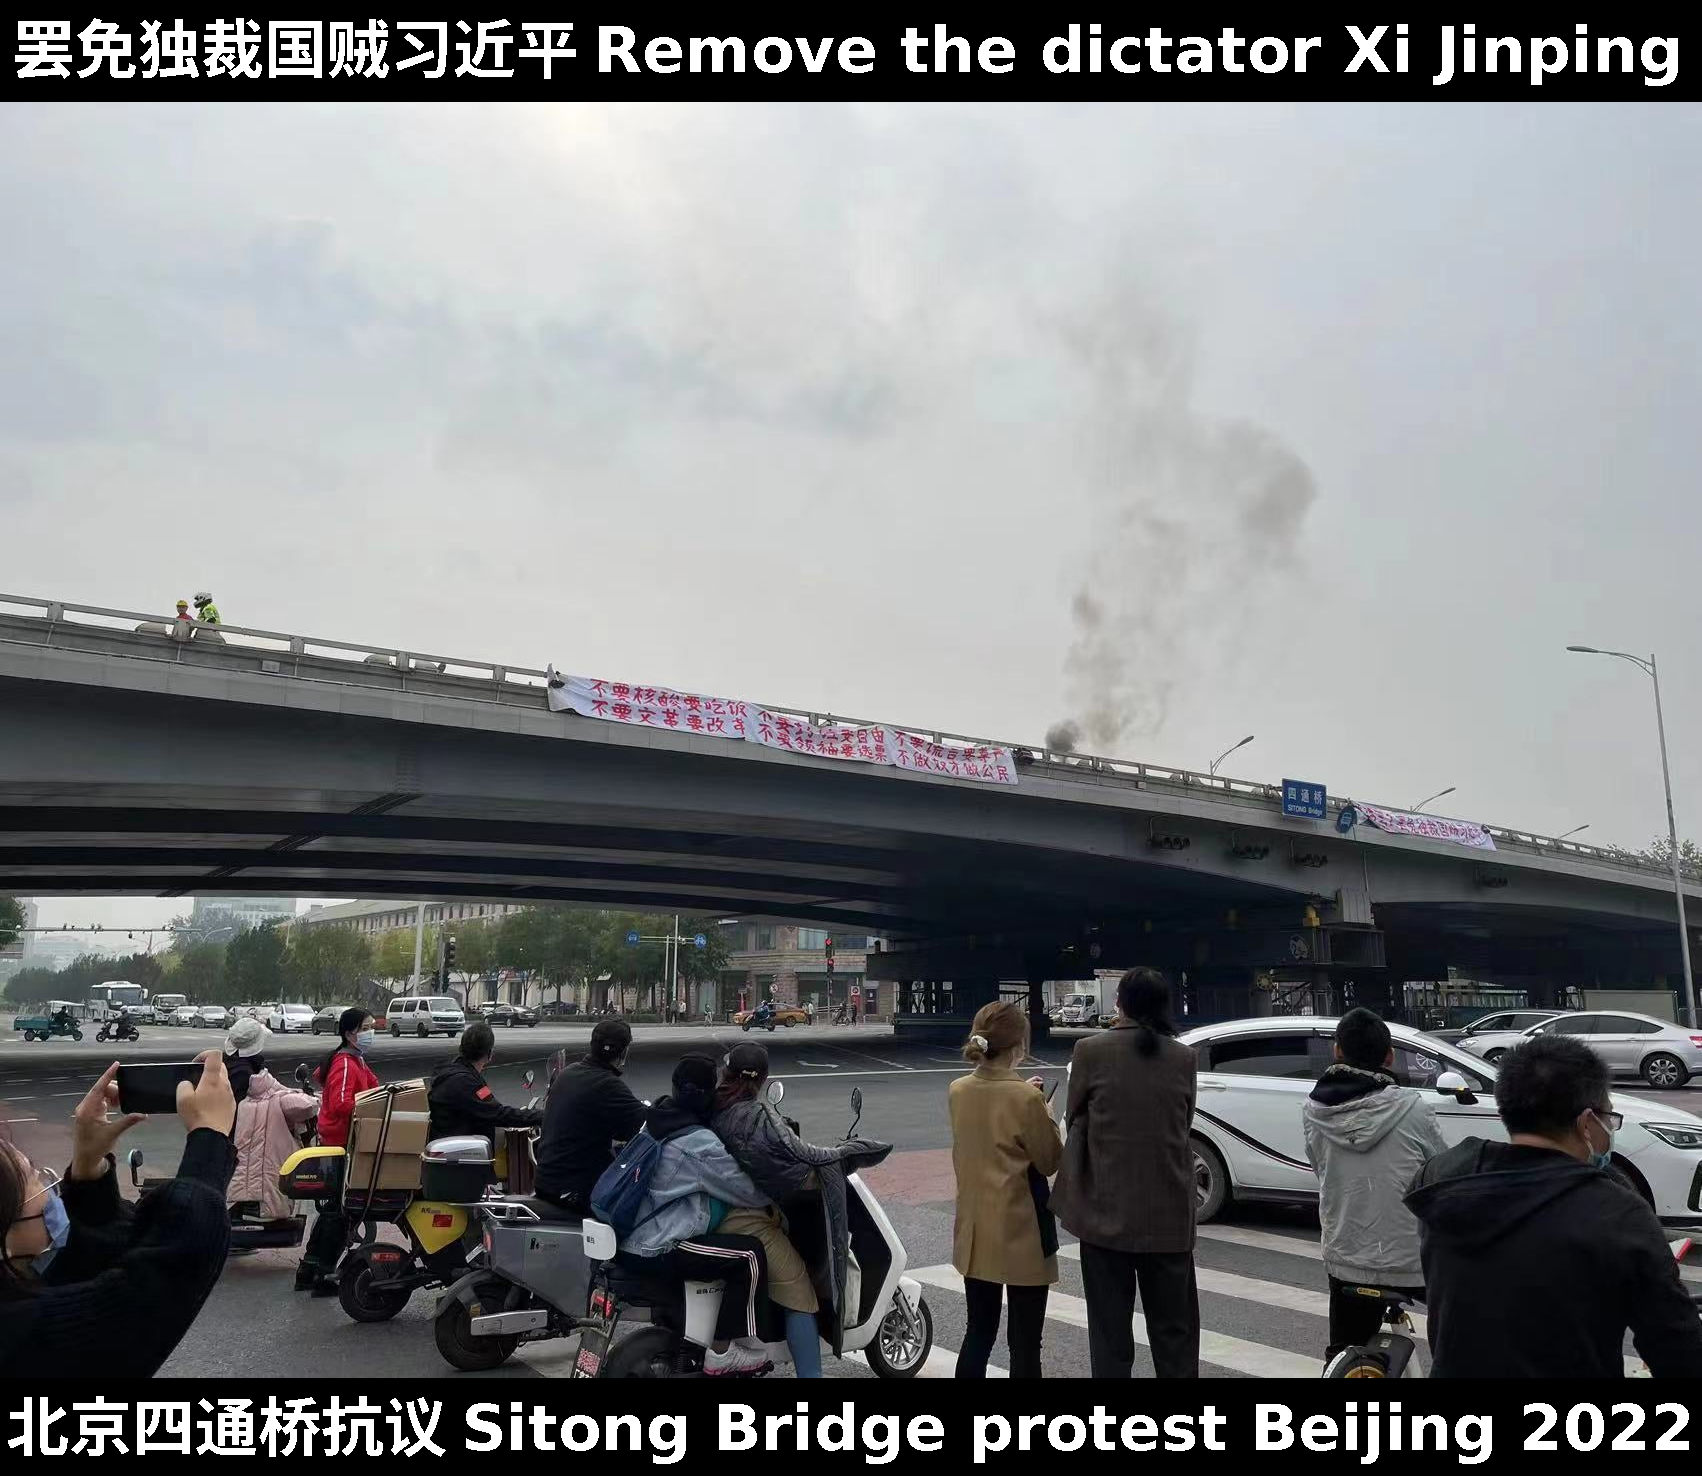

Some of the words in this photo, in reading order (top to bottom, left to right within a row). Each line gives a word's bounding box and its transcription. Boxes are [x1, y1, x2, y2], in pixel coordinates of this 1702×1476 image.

[590, 678, 748, 717] 不要核酸要吃饭
[1287, 787, 1323, 806] 四通桥
[1287, 804, 1307, 813] SITONG
